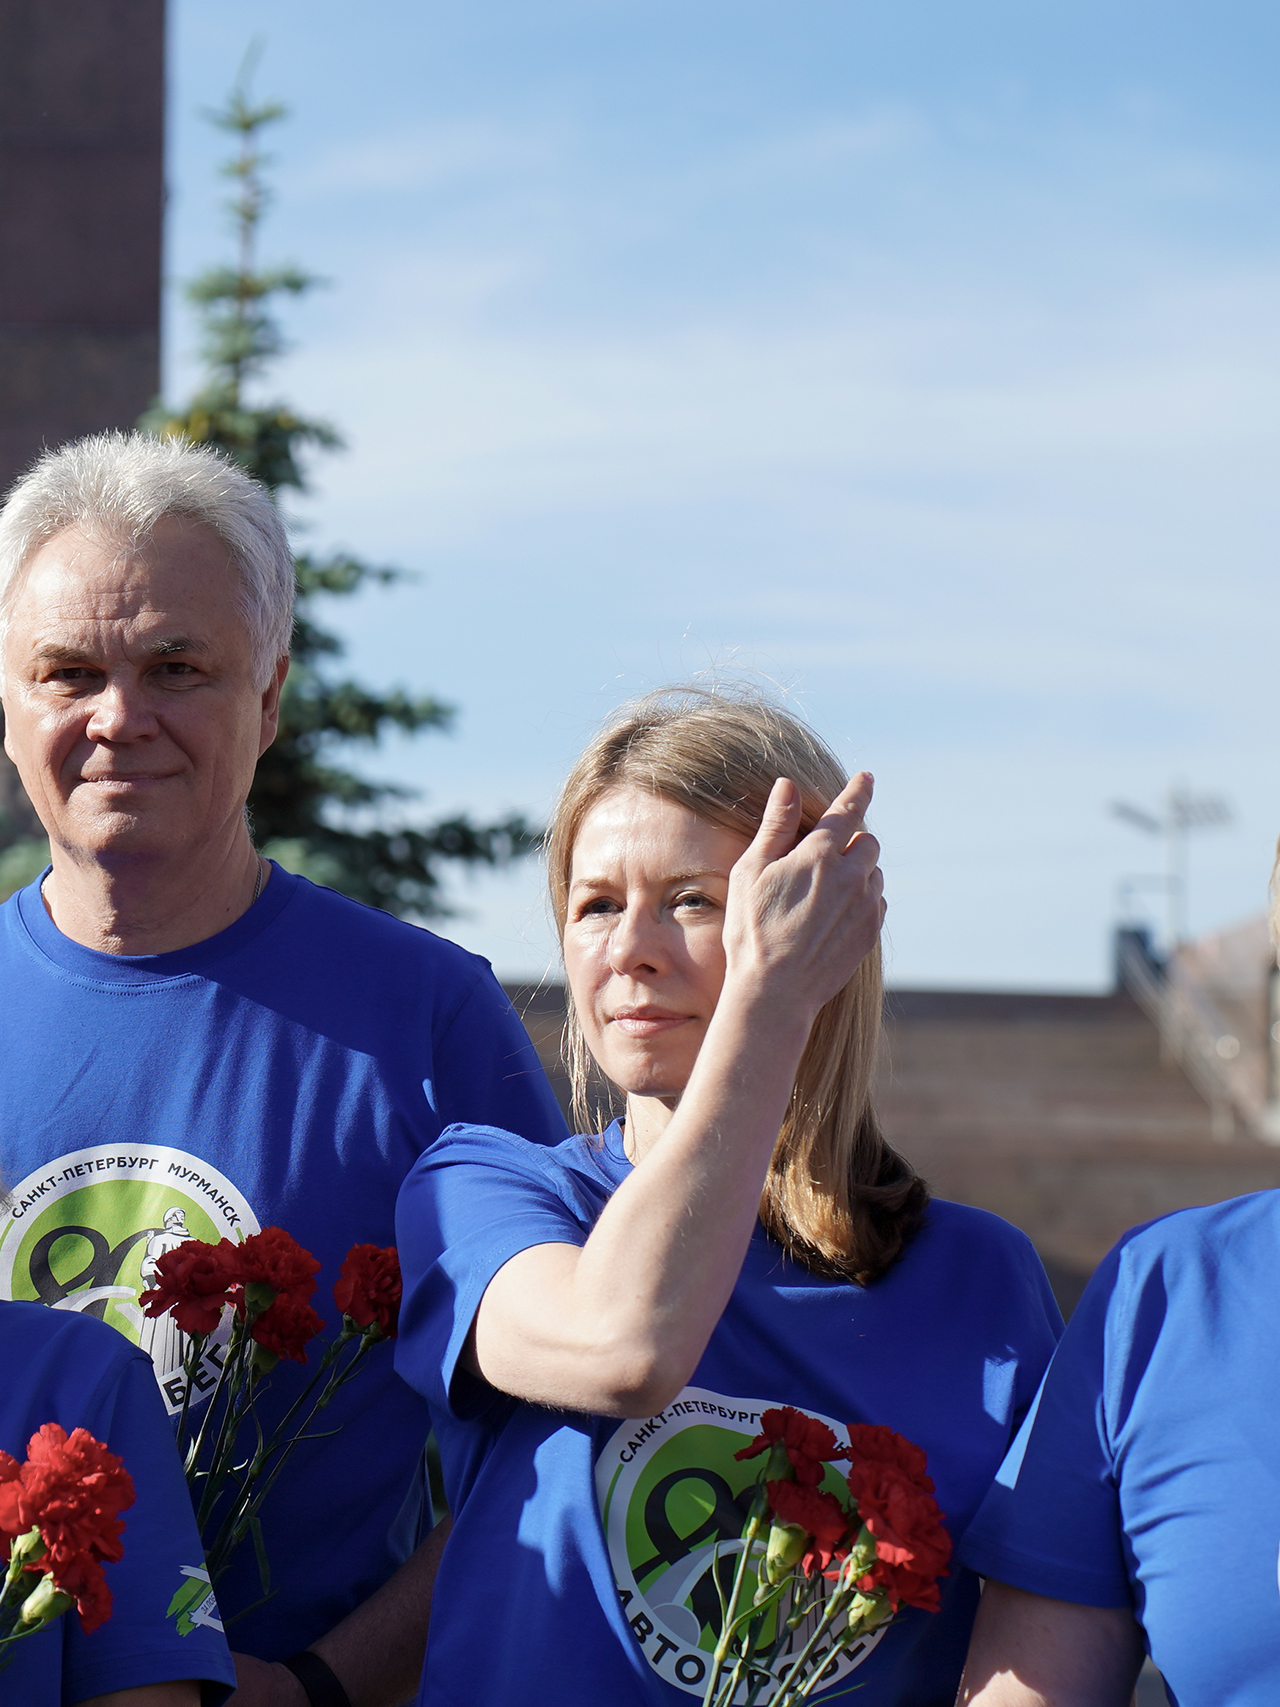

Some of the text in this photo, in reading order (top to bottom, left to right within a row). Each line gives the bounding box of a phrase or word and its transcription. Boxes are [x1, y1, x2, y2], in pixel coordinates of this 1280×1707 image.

[11, 1155, 242, 1228] САНКТ-ПЕТЕРБУРГ МУРМАНСК
[619, 1399, 761, 1464] САНКТ-ПЕТЕРБУРГ
[617, 1589, 877, 1696] АВТОРОБ
